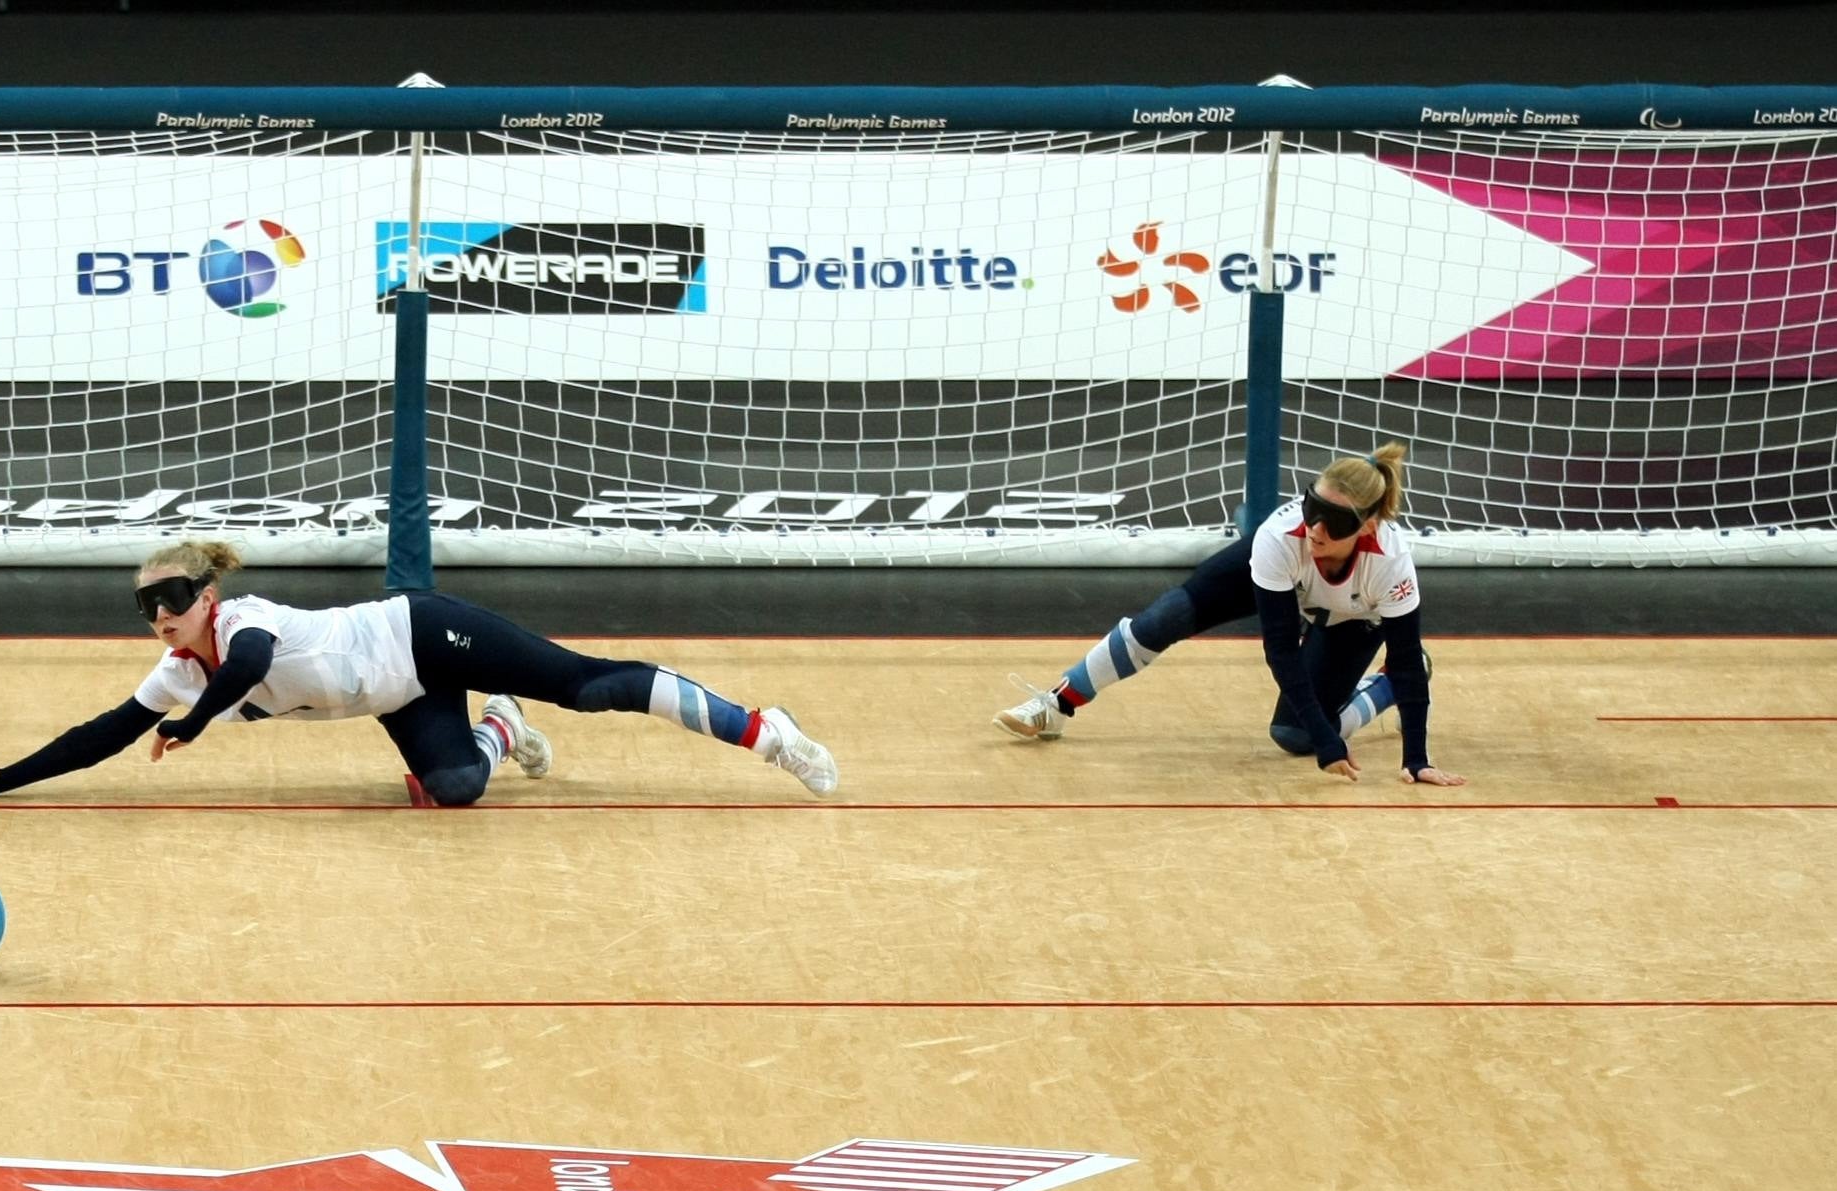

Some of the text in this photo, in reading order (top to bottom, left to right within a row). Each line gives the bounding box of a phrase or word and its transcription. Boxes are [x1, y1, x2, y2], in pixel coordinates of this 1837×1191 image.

[156, 112, 316, 130] Paralympic Games
[501, 113, 603, 128] London 2012
[787, 113, 947, 130] Paralympic Games
[1132, 107, 1235, 124] London 2012
[1420, 107, 1580, 126] Paralympic Games
[1753, 107, 1815, 124] London
[76, 251, 190, 296] BT
[388, 253, 680, 283] POWERADE
[768, 245, 1035, 291] Deloitte.
[572, 490, 1126, 521] 2012
